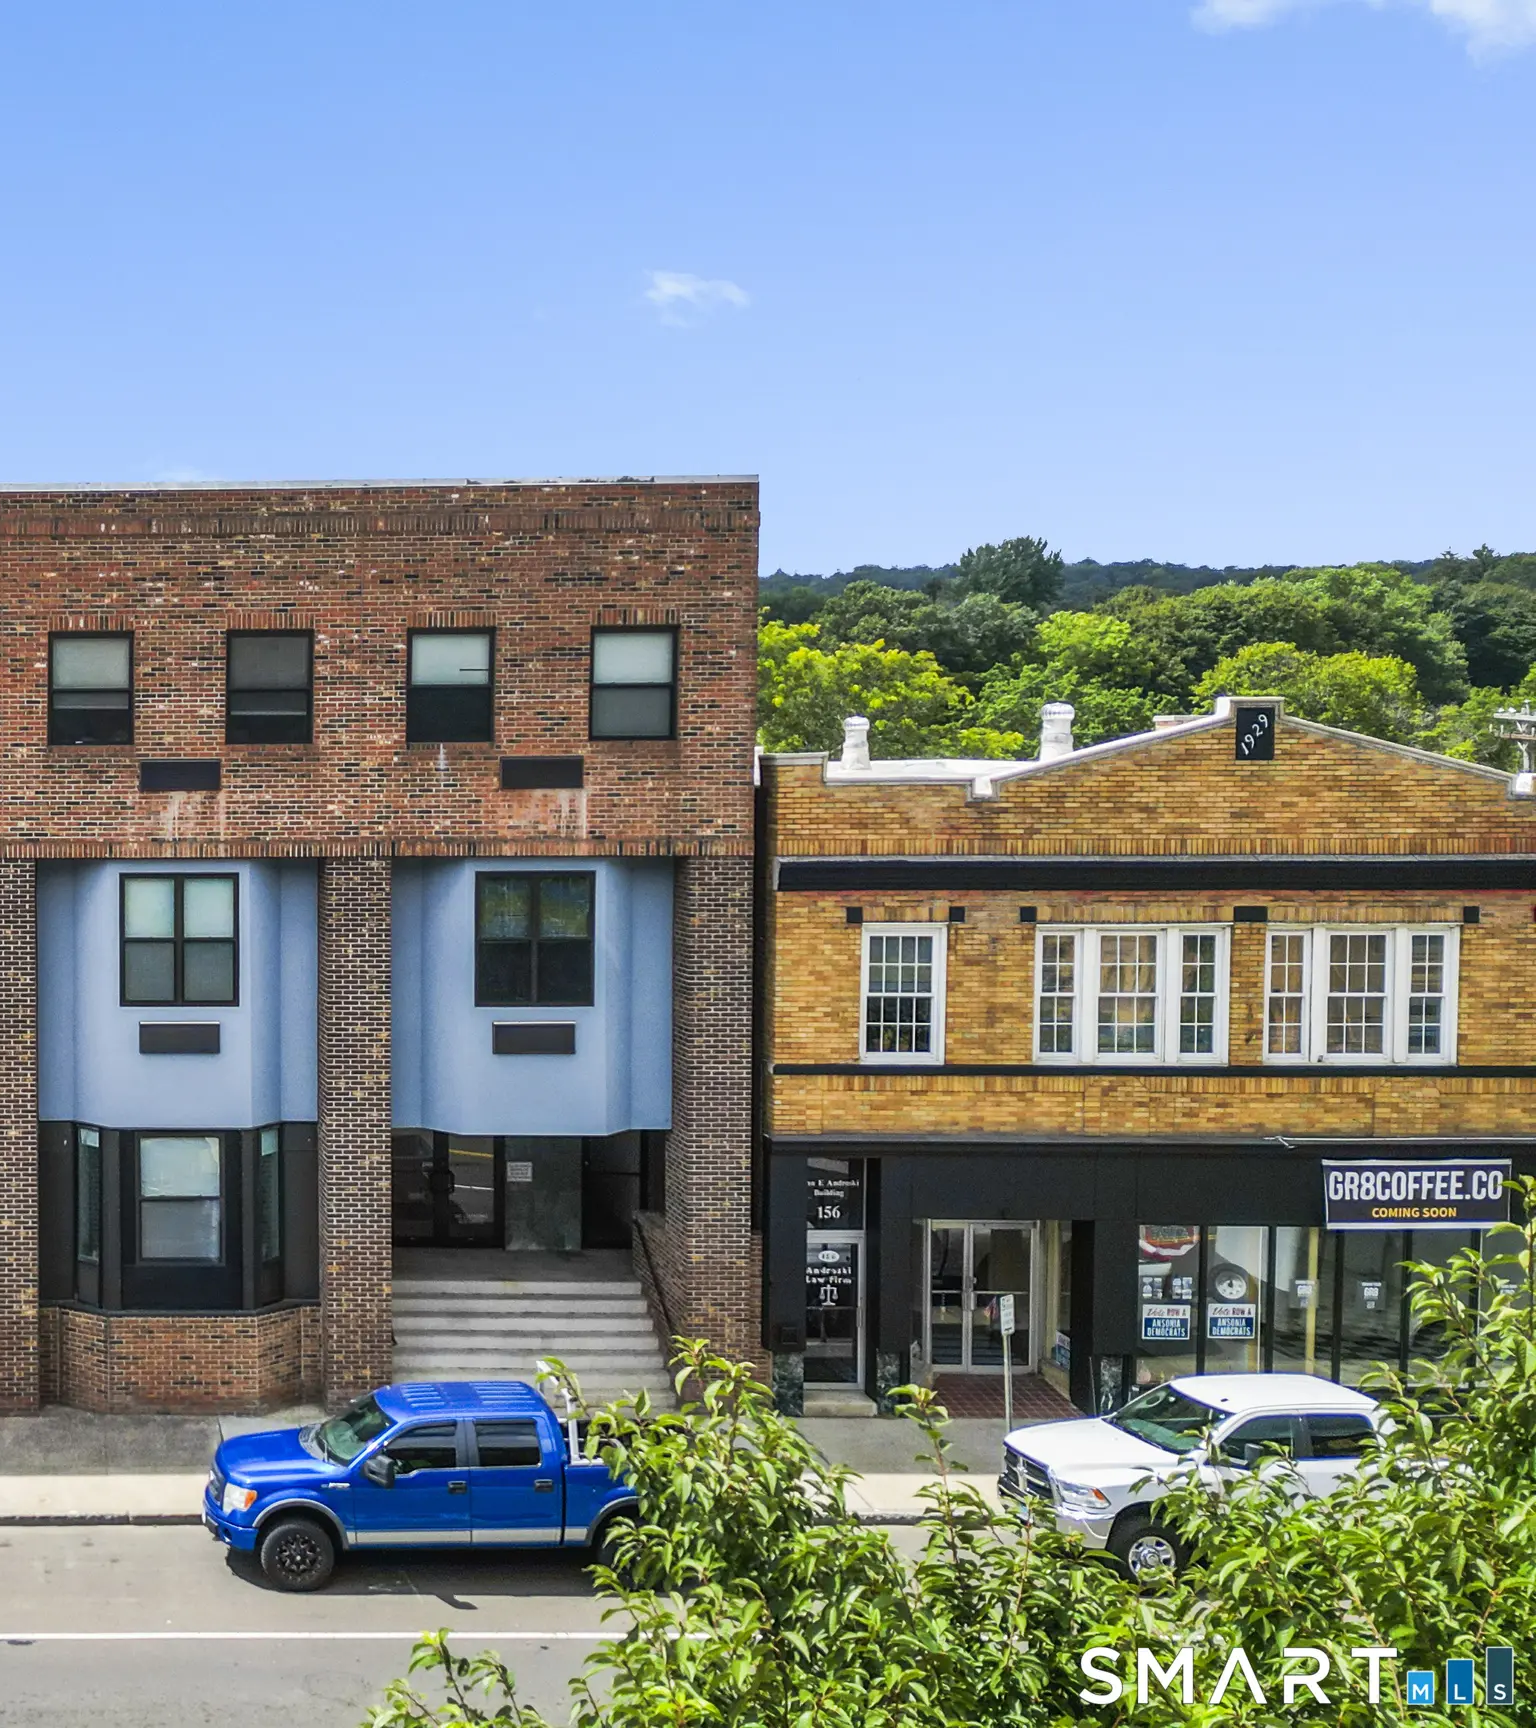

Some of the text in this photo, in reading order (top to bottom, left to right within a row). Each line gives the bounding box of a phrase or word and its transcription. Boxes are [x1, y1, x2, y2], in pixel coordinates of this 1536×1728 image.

[1241, 714, 1268, 755] 1929
[1328, 1170, 1504, 1201] GR8COFFEE.CO
[817, 1205, 841, 1219] 156
[1372, 1207, 1457, 1218] COMING SOON
[805, 1266, 852, 1275] Androski
[805, 1275, 825, 1284] Law
[1232, 1307, 1246, 1316] ROW
[1151, 1319, 1181, 1328] ANSONIA
[1217, 1318, 1246, 1327] ANSONIA
[1147, 1328, 1186, 1337] DEMOCRATS
[1212, 1327, 1251, 1336] DEMOCRATS
